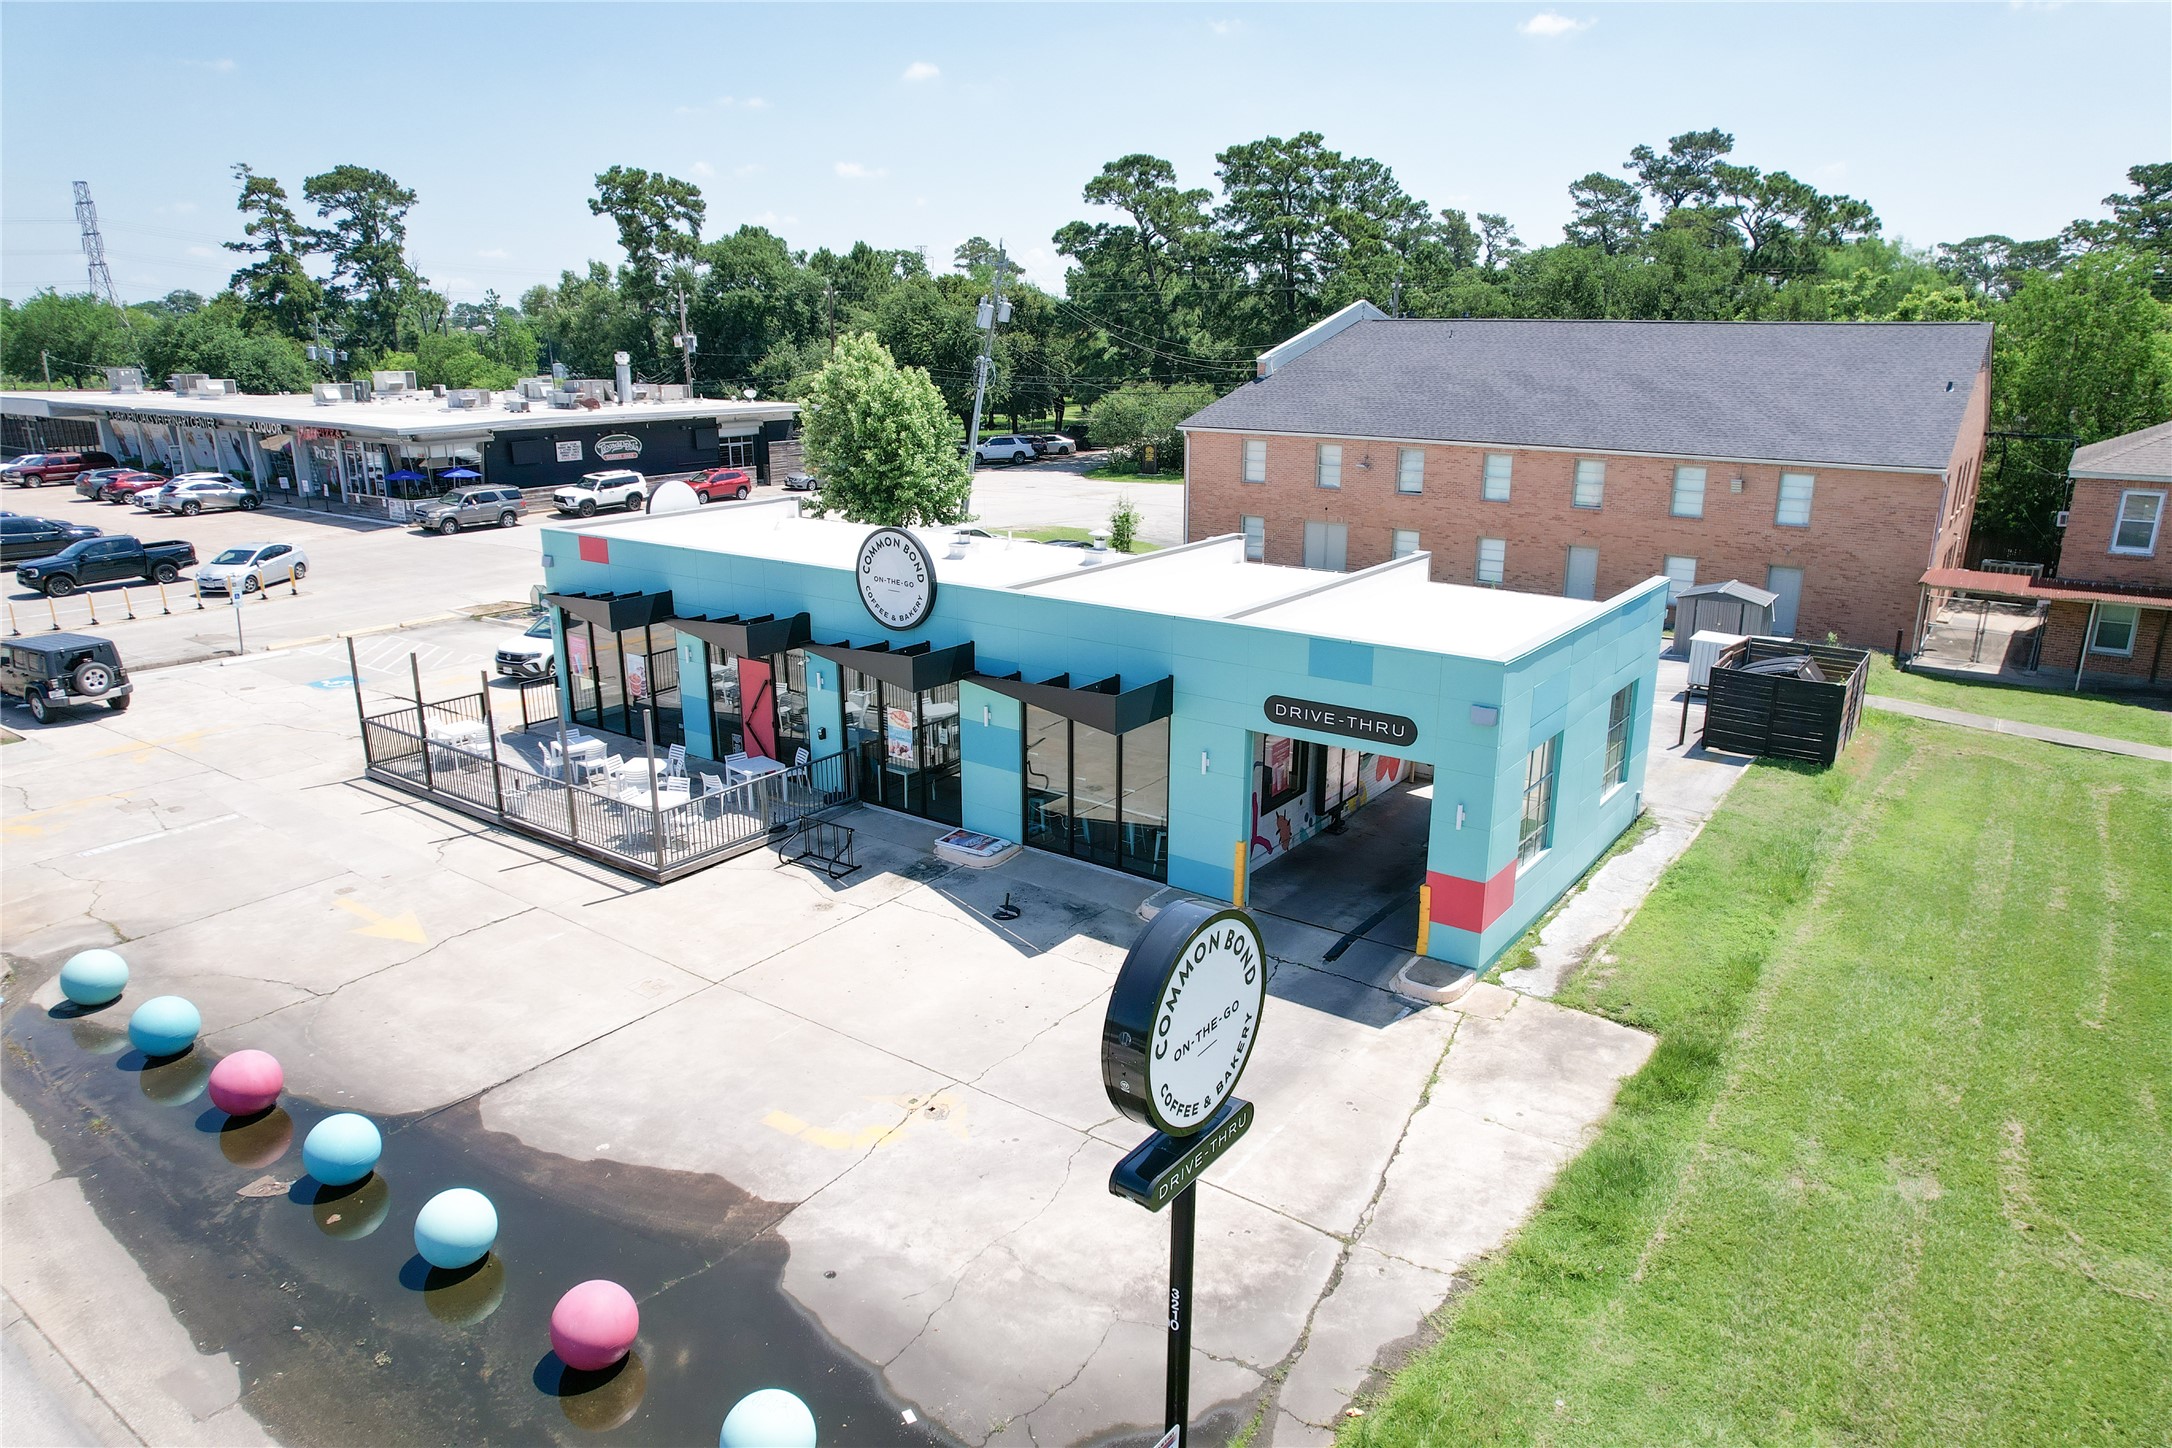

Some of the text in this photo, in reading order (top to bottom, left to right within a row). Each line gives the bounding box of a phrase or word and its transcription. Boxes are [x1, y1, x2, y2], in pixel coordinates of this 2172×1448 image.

[190, 416, 216, 429] CENTER
[253, 421, 283, 435] LIQUOR
[863, 536, 925, 583] COMMON BOND
[873, 575, 915, 588] ON-THE-GO
[865, 585, 889, 619] COFFEE
[899, 595, 923, 622] BAKERY
[1275, 703, 1405, 737] DRIVE-THRU
[1155, 928, 1257, 1060] COMMON BOND
[1174, 999, 1240, 1063] ON-THE-GO
[1160, 1012, 1253, 1118] COFFEE & BAKERY
[1158, 1112, 1247, 1200] DRIVE-THRU
[1170, 1288, 1180, 1331] 3210
